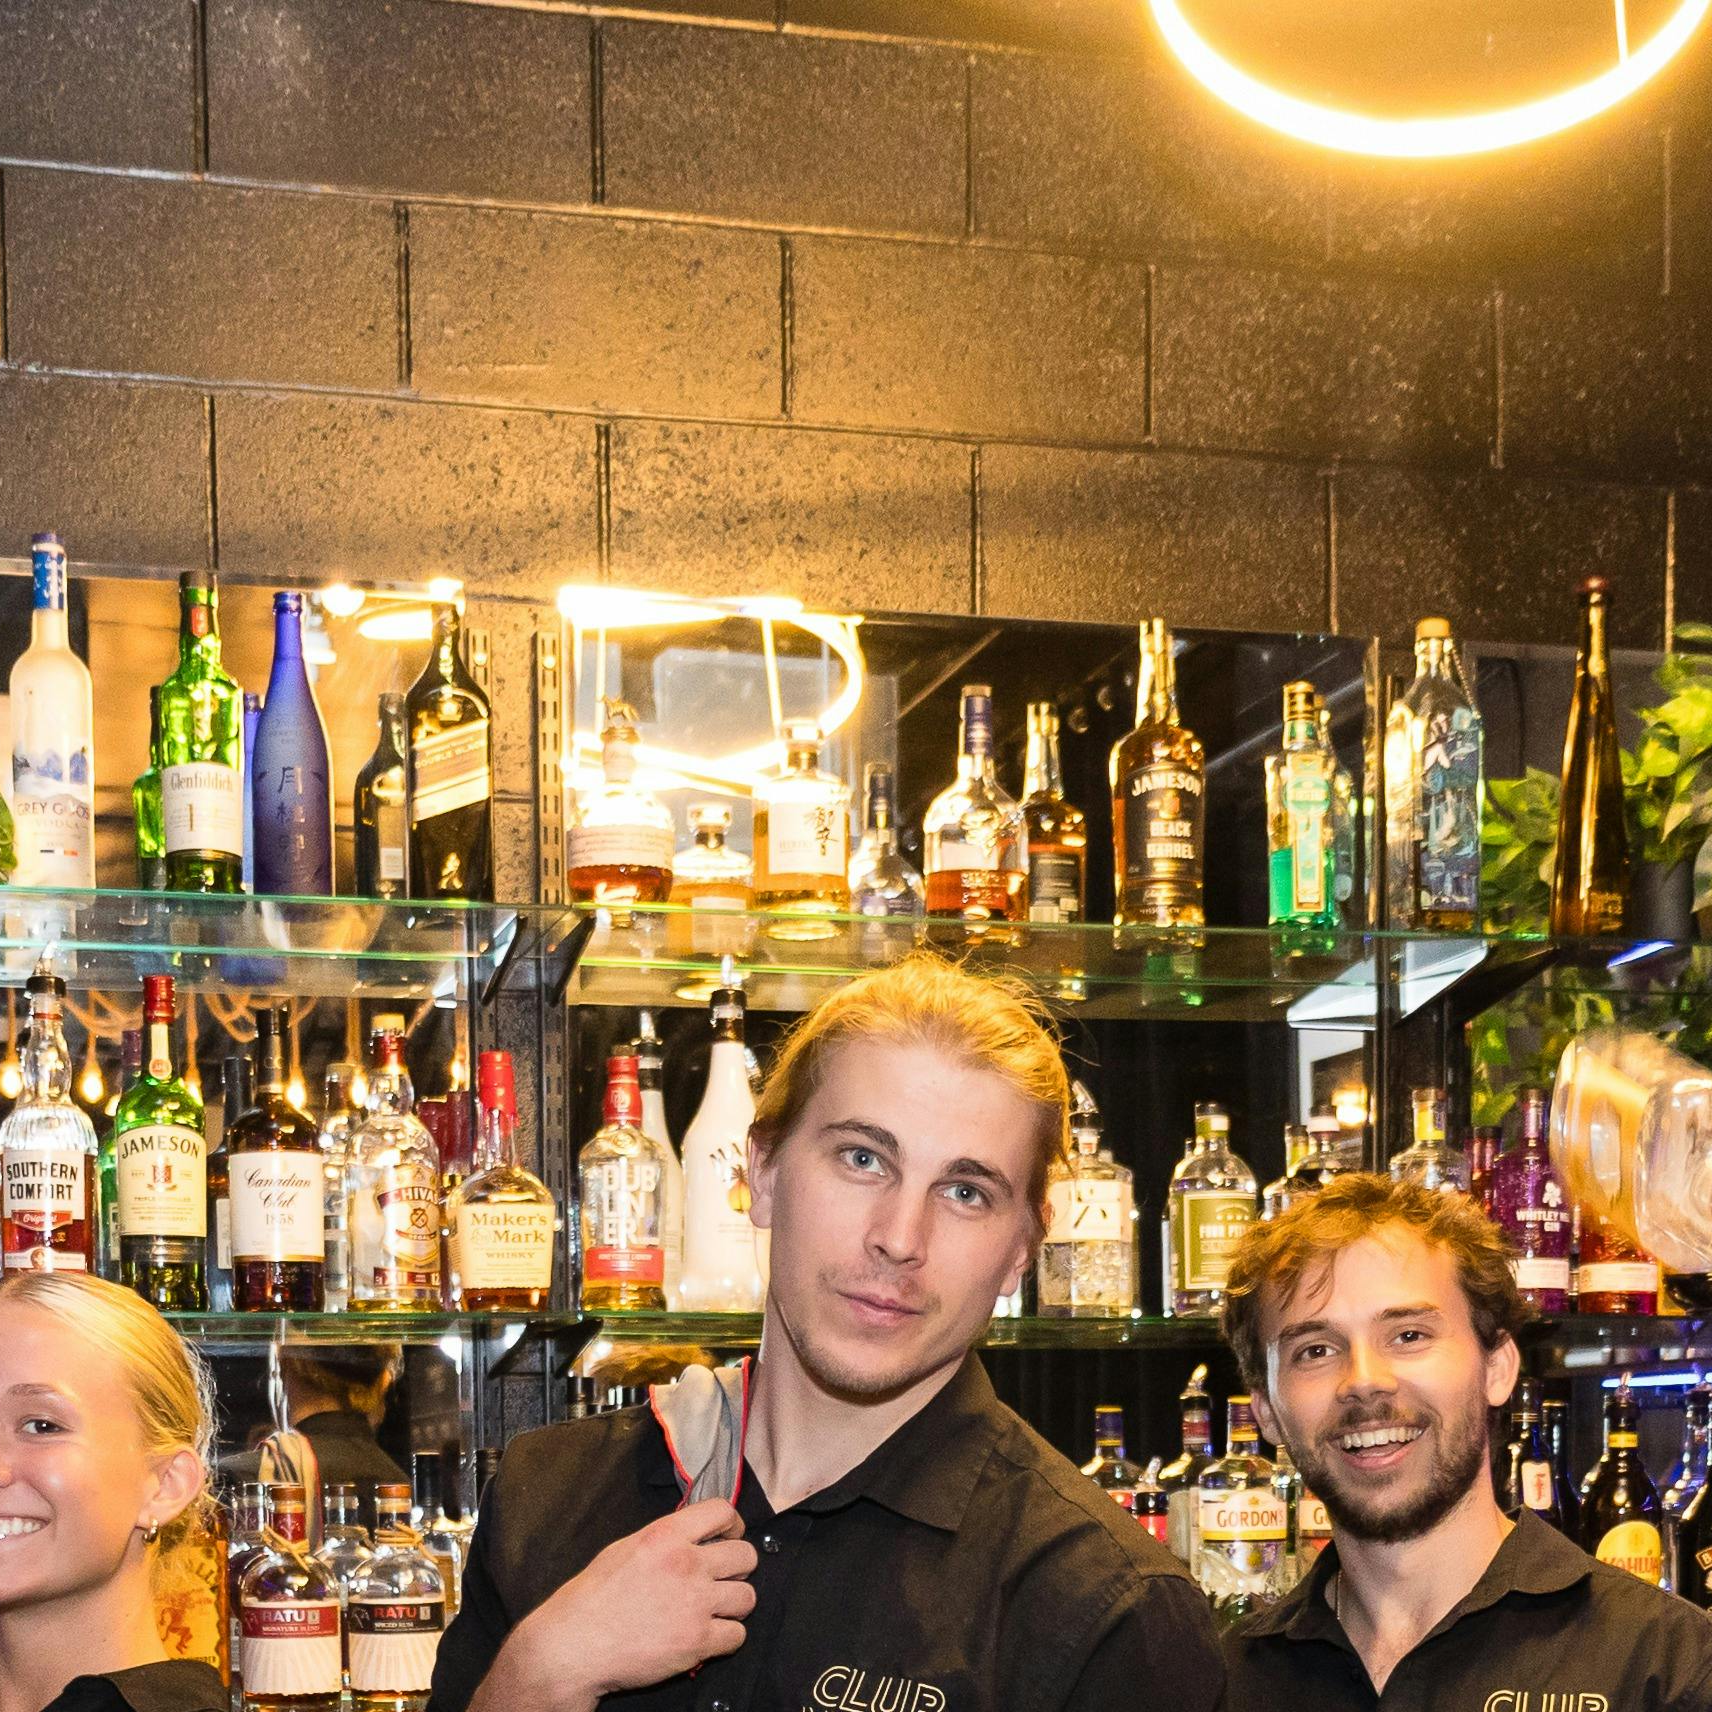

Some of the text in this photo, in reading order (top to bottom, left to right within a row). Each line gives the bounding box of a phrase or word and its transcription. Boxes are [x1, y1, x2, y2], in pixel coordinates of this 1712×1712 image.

[170, 771, 235, 793] Glenfiddich
[1131, 772, 1202, 798] JAMESON
[1149, 820, 1192, 837] BLACK
[1145, 842, 1195, 859] BARREL
[121, 1135, 201, 1160] JAMESON
[6, 1161, 79, 1182] SOUTHERN
[603, 1163, 657, 1193] DUB
[471, 1212, 549, 1228] Maker's
[1516, 1209, 1559, 1222] WHITLEY
[493, 1229, 547, 1244] Mark
[1217, 1509, 1286, 1528] GORDON'S
[262, 1608, 306, 1623] RATU
[373, 1606, 418, 1620] RATU
